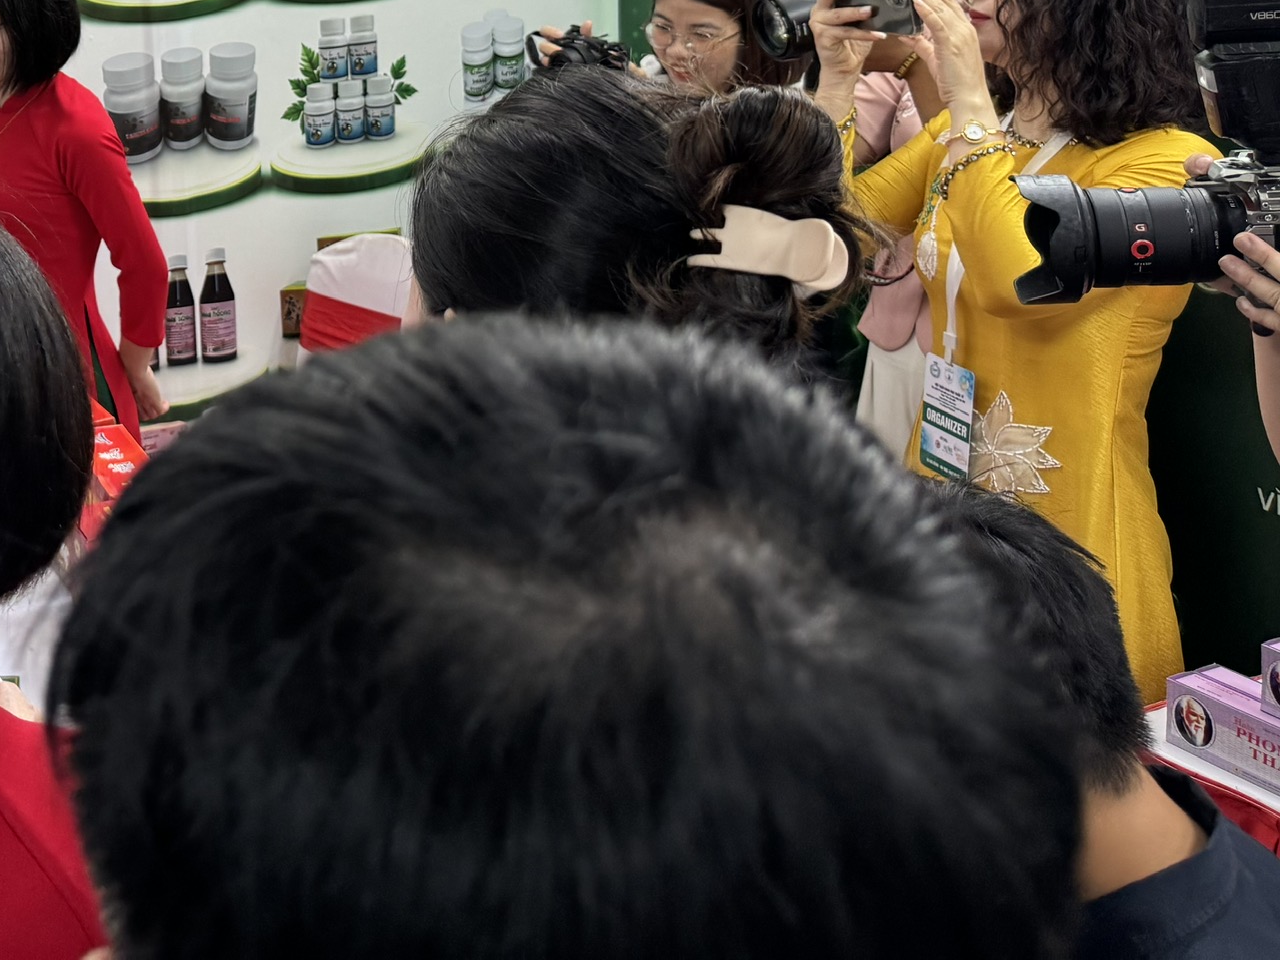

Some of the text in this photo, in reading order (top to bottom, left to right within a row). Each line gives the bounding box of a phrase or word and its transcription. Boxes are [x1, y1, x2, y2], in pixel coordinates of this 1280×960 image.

[1135, 224, 1146, 232] G
[926, 407, 968, 438] ORGANIZER
[1236, 726, 1280, 754] PHO
[1249, 746, 1280, 771] TH
